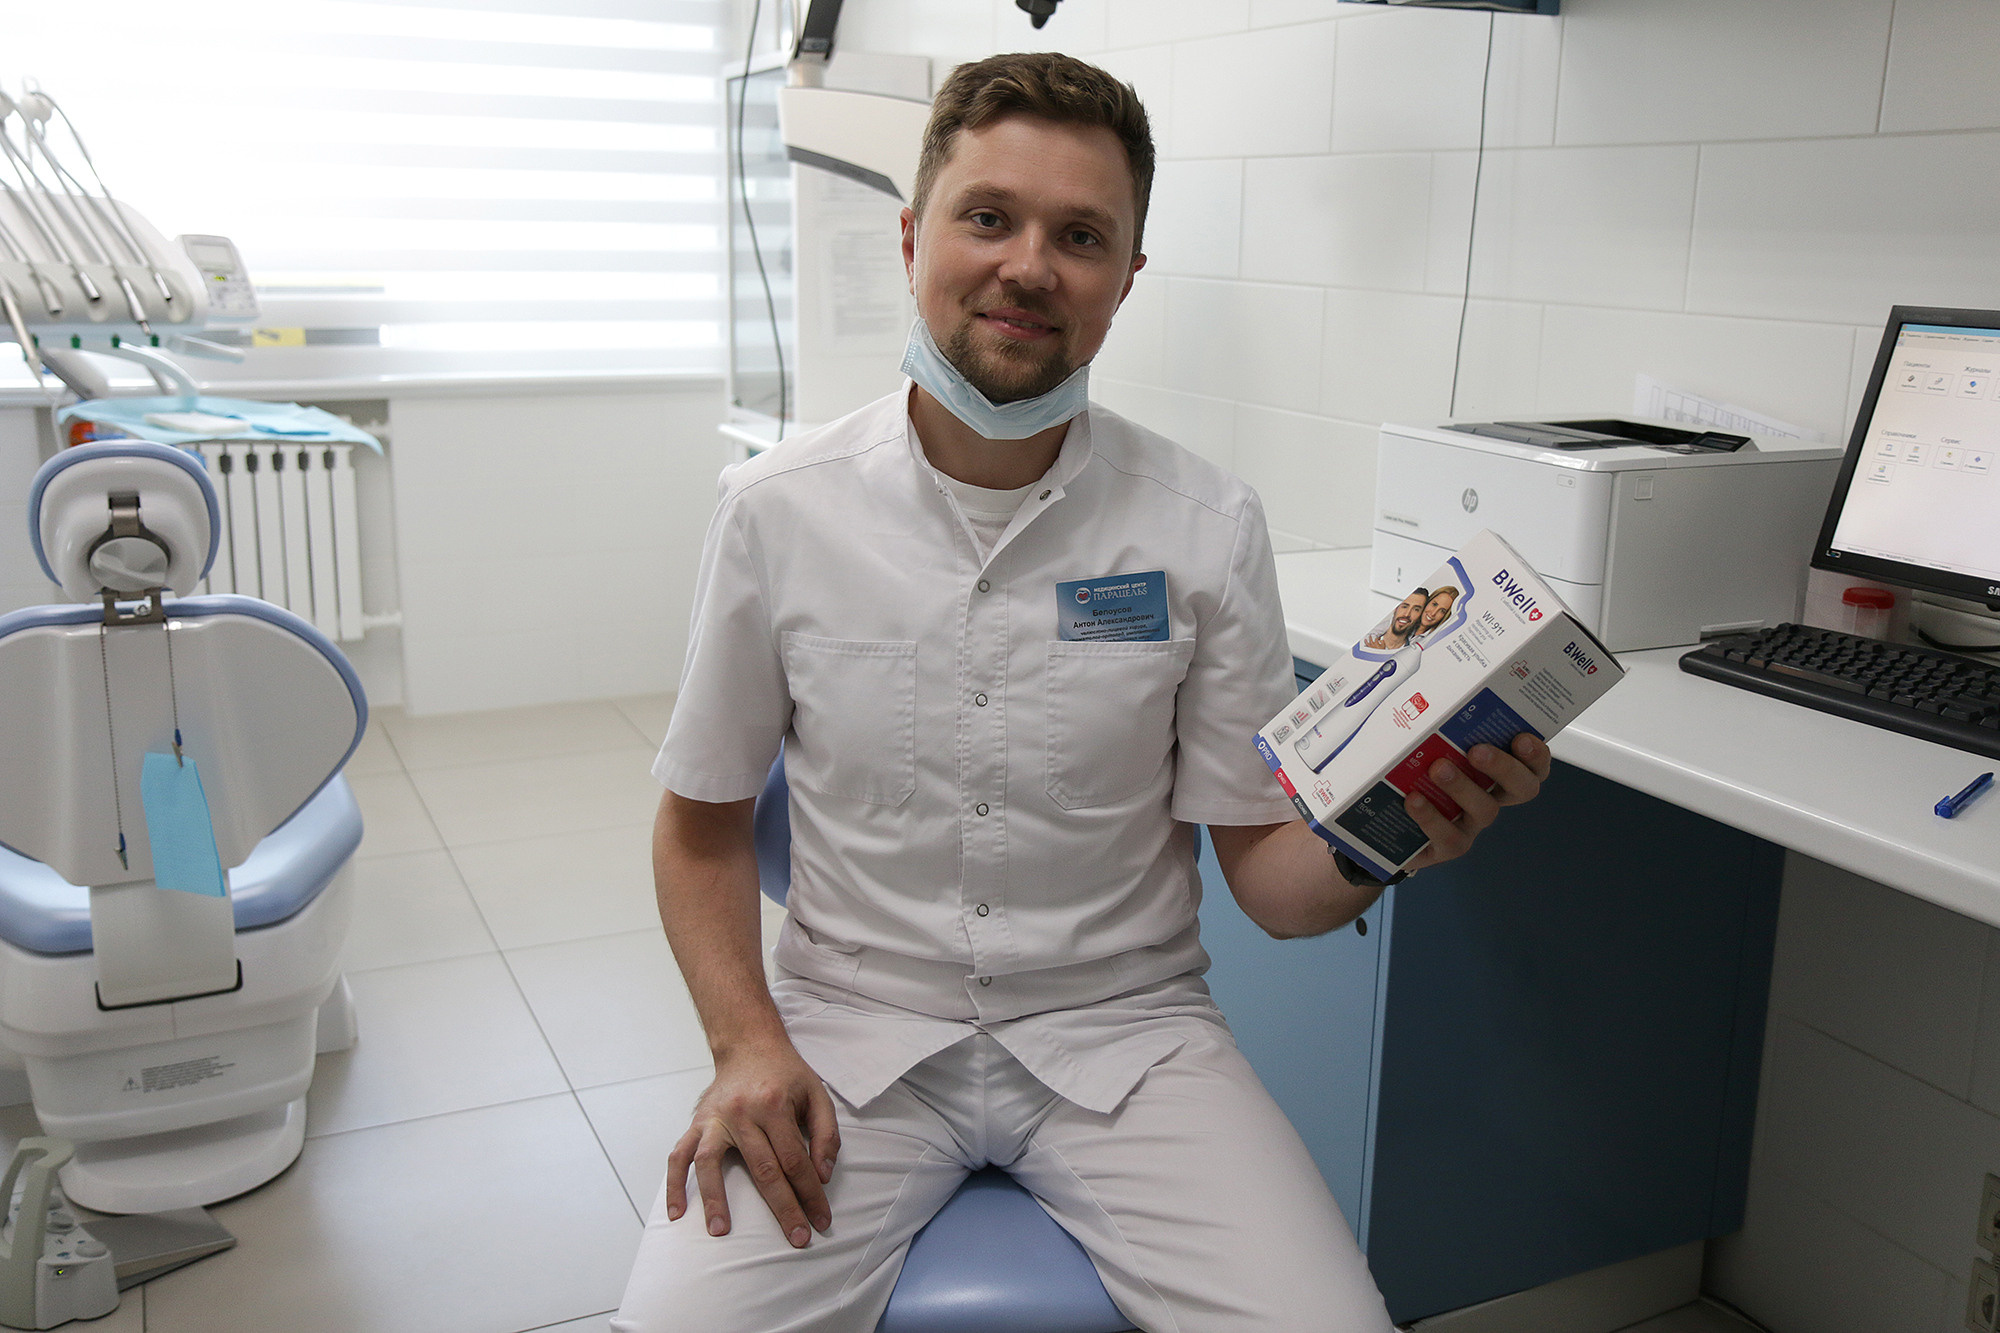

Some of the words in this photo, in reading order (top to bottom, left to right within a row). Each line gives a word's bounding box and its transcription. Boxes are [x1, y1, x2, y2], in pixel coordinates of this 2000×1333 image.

[1492, 568, 1537, 614] B.Well
[1073, 621, 1096, 629] Антон
[1097, 614, 1154, 626] Александрович
[1481, 610, 1505, 637] WI-911
[1563, 641, 1594, 671] B.Well
[1261, 746, 1273, 760] PRO
[1358, 802, 1376, 817] TECHNO
